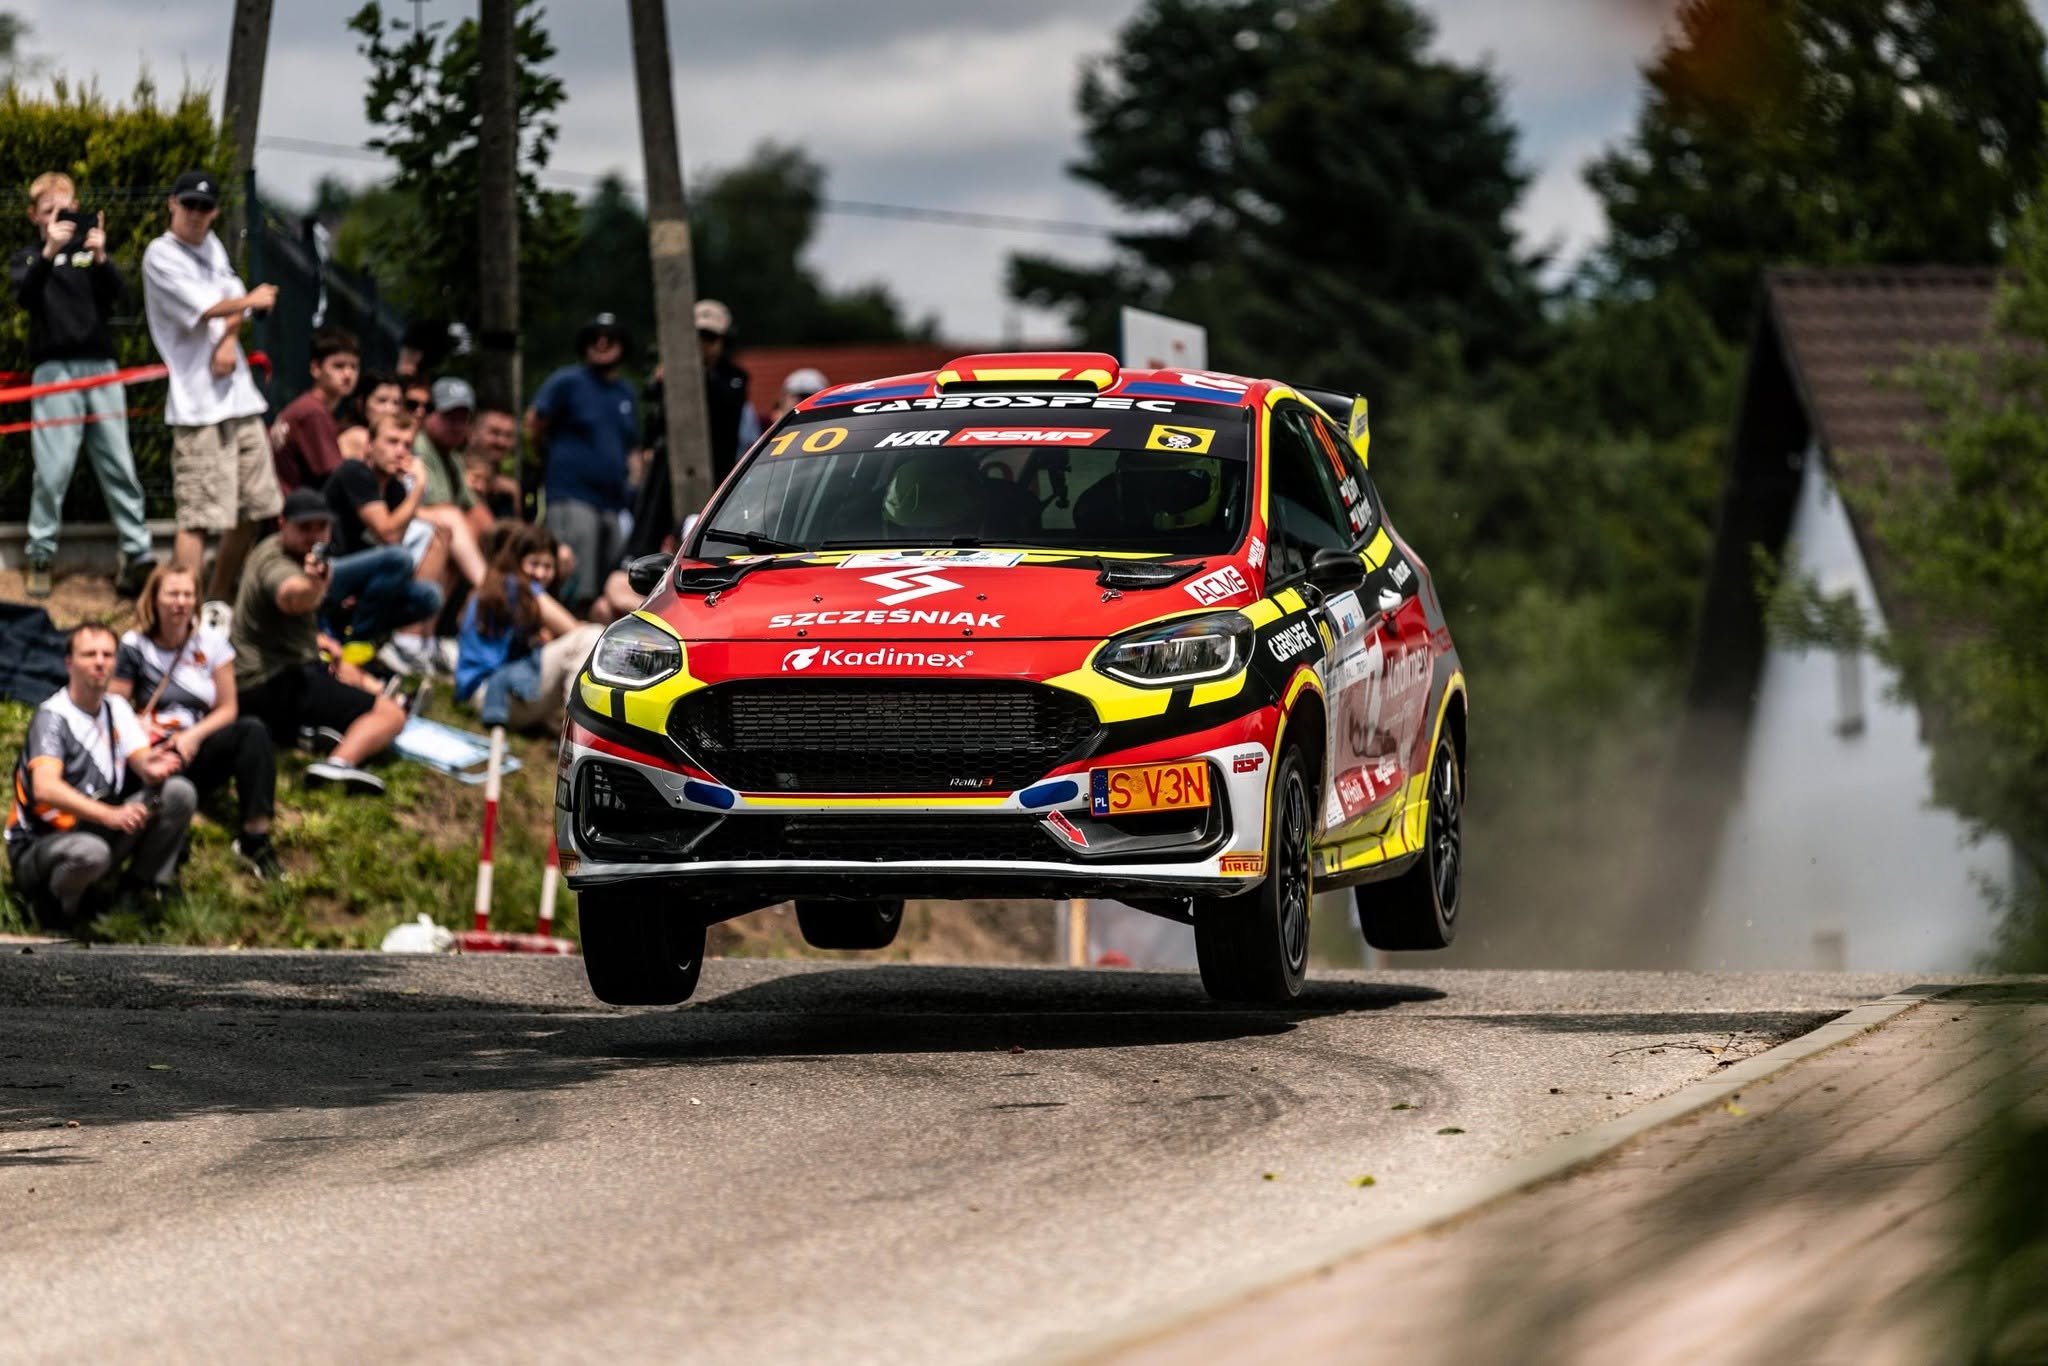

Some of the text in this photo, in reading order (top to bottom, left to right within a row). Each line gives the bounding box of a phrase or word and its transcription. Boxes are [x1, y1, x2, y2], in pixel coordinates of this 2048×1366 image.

[852, 396, 1176, 414] CARBOSPEC
[769, 427, 849, 456] 10
[959, 430, 1086, 443] RSMP
[1193, 569, 1247, 604] ACME
[768, 608, 1006, 628] SZCZĘŚNIAK
[949, 777, 993, 788] Rally3
[1110, 766, 1205, 809] S V3N
[1094, 796, 1108, 808] PL
